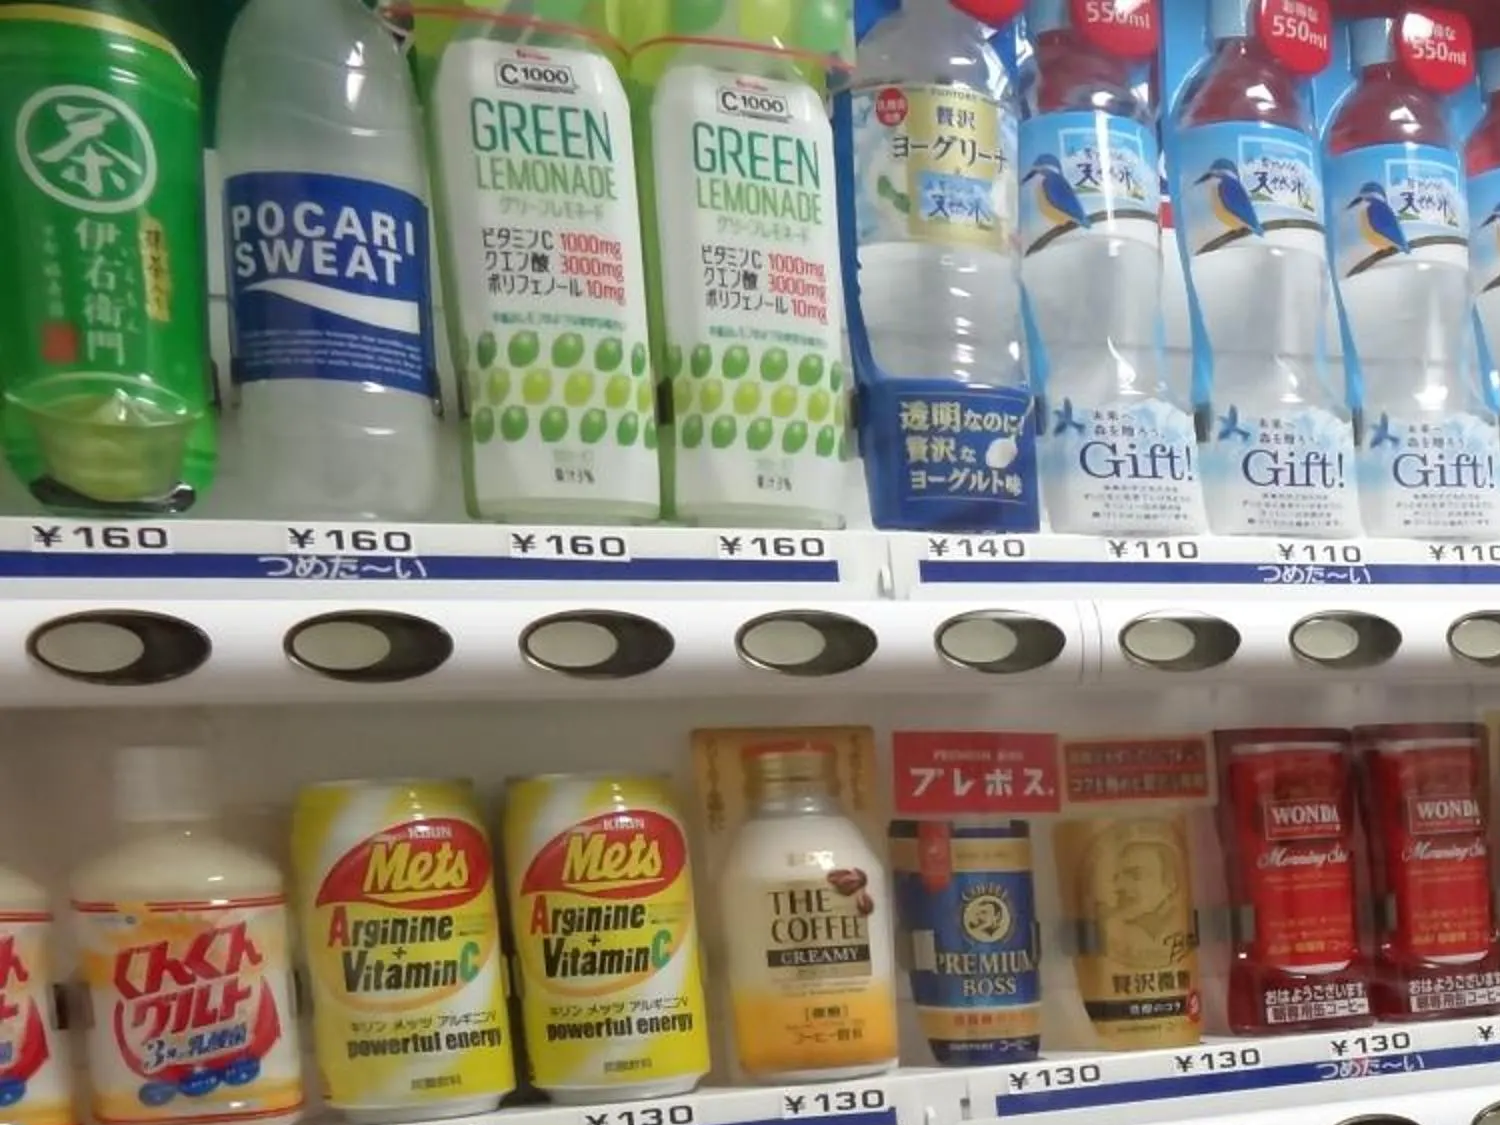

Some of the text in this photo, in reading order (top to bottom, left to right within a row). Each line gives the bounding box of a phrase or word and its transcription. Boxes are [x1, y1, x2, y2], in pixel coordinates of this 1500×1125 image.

[1272, 15, 1327, 50] 550ml
[1412, 40, 1467, 67] 550ml
[471, 98, 613, 162] GREEN
[692, 122, 820, 189] GREEN
[475, 156, 619, 200] LEMONADE
[696, 177, 822, 225] LEMONADE
[231, 201, 416, 256] POCARI
[236, 239, 403, 286] SWEAT
[586, 279, 626, 306] 10mg
[791, 299, 828, 325] 10mg
[1080, 441, 1193, 481] Gift!
[1242, 449, 1344, 489] Gift!
[1393, 452, 1495, 490] Gift!
[32, 525, 169, 549] ¥160
[288, 527, 412, 551] ¥160
[511, 533, 626, 556] ¥160
[720, 536, 825, 557] ¥160
[928, 538, 1025, 558] ¥140
[1108, 540, 1199, 559] ¥110
[1278, 543, 1361, 563] ¥110
[363, 840, 470, 893] Mets
[562, 832, 662, 883] Mets
[531, 895, 645, 936] Arginine
[768, 888, 832, 917] THE
[328, 906, 453, 948] Arginine
[771, 915, 864, 945] COFFEE
[781, 947, 859, 965] CREAMY
[936, 948, 1033, 975] PREMIUM
[962, 977, 1017, 997] BOSS
[546, 1016, 632, 1041] powerful
[347, 1031, 442, 1060] powerful
[1331, 1032, 1411, 1057] ¥130
[1176, 1048, 1261, 1073] ¥130
[1009, 1065, 1100, 1090] ¥130
[784, 1089, 885, 1114] ¥130
